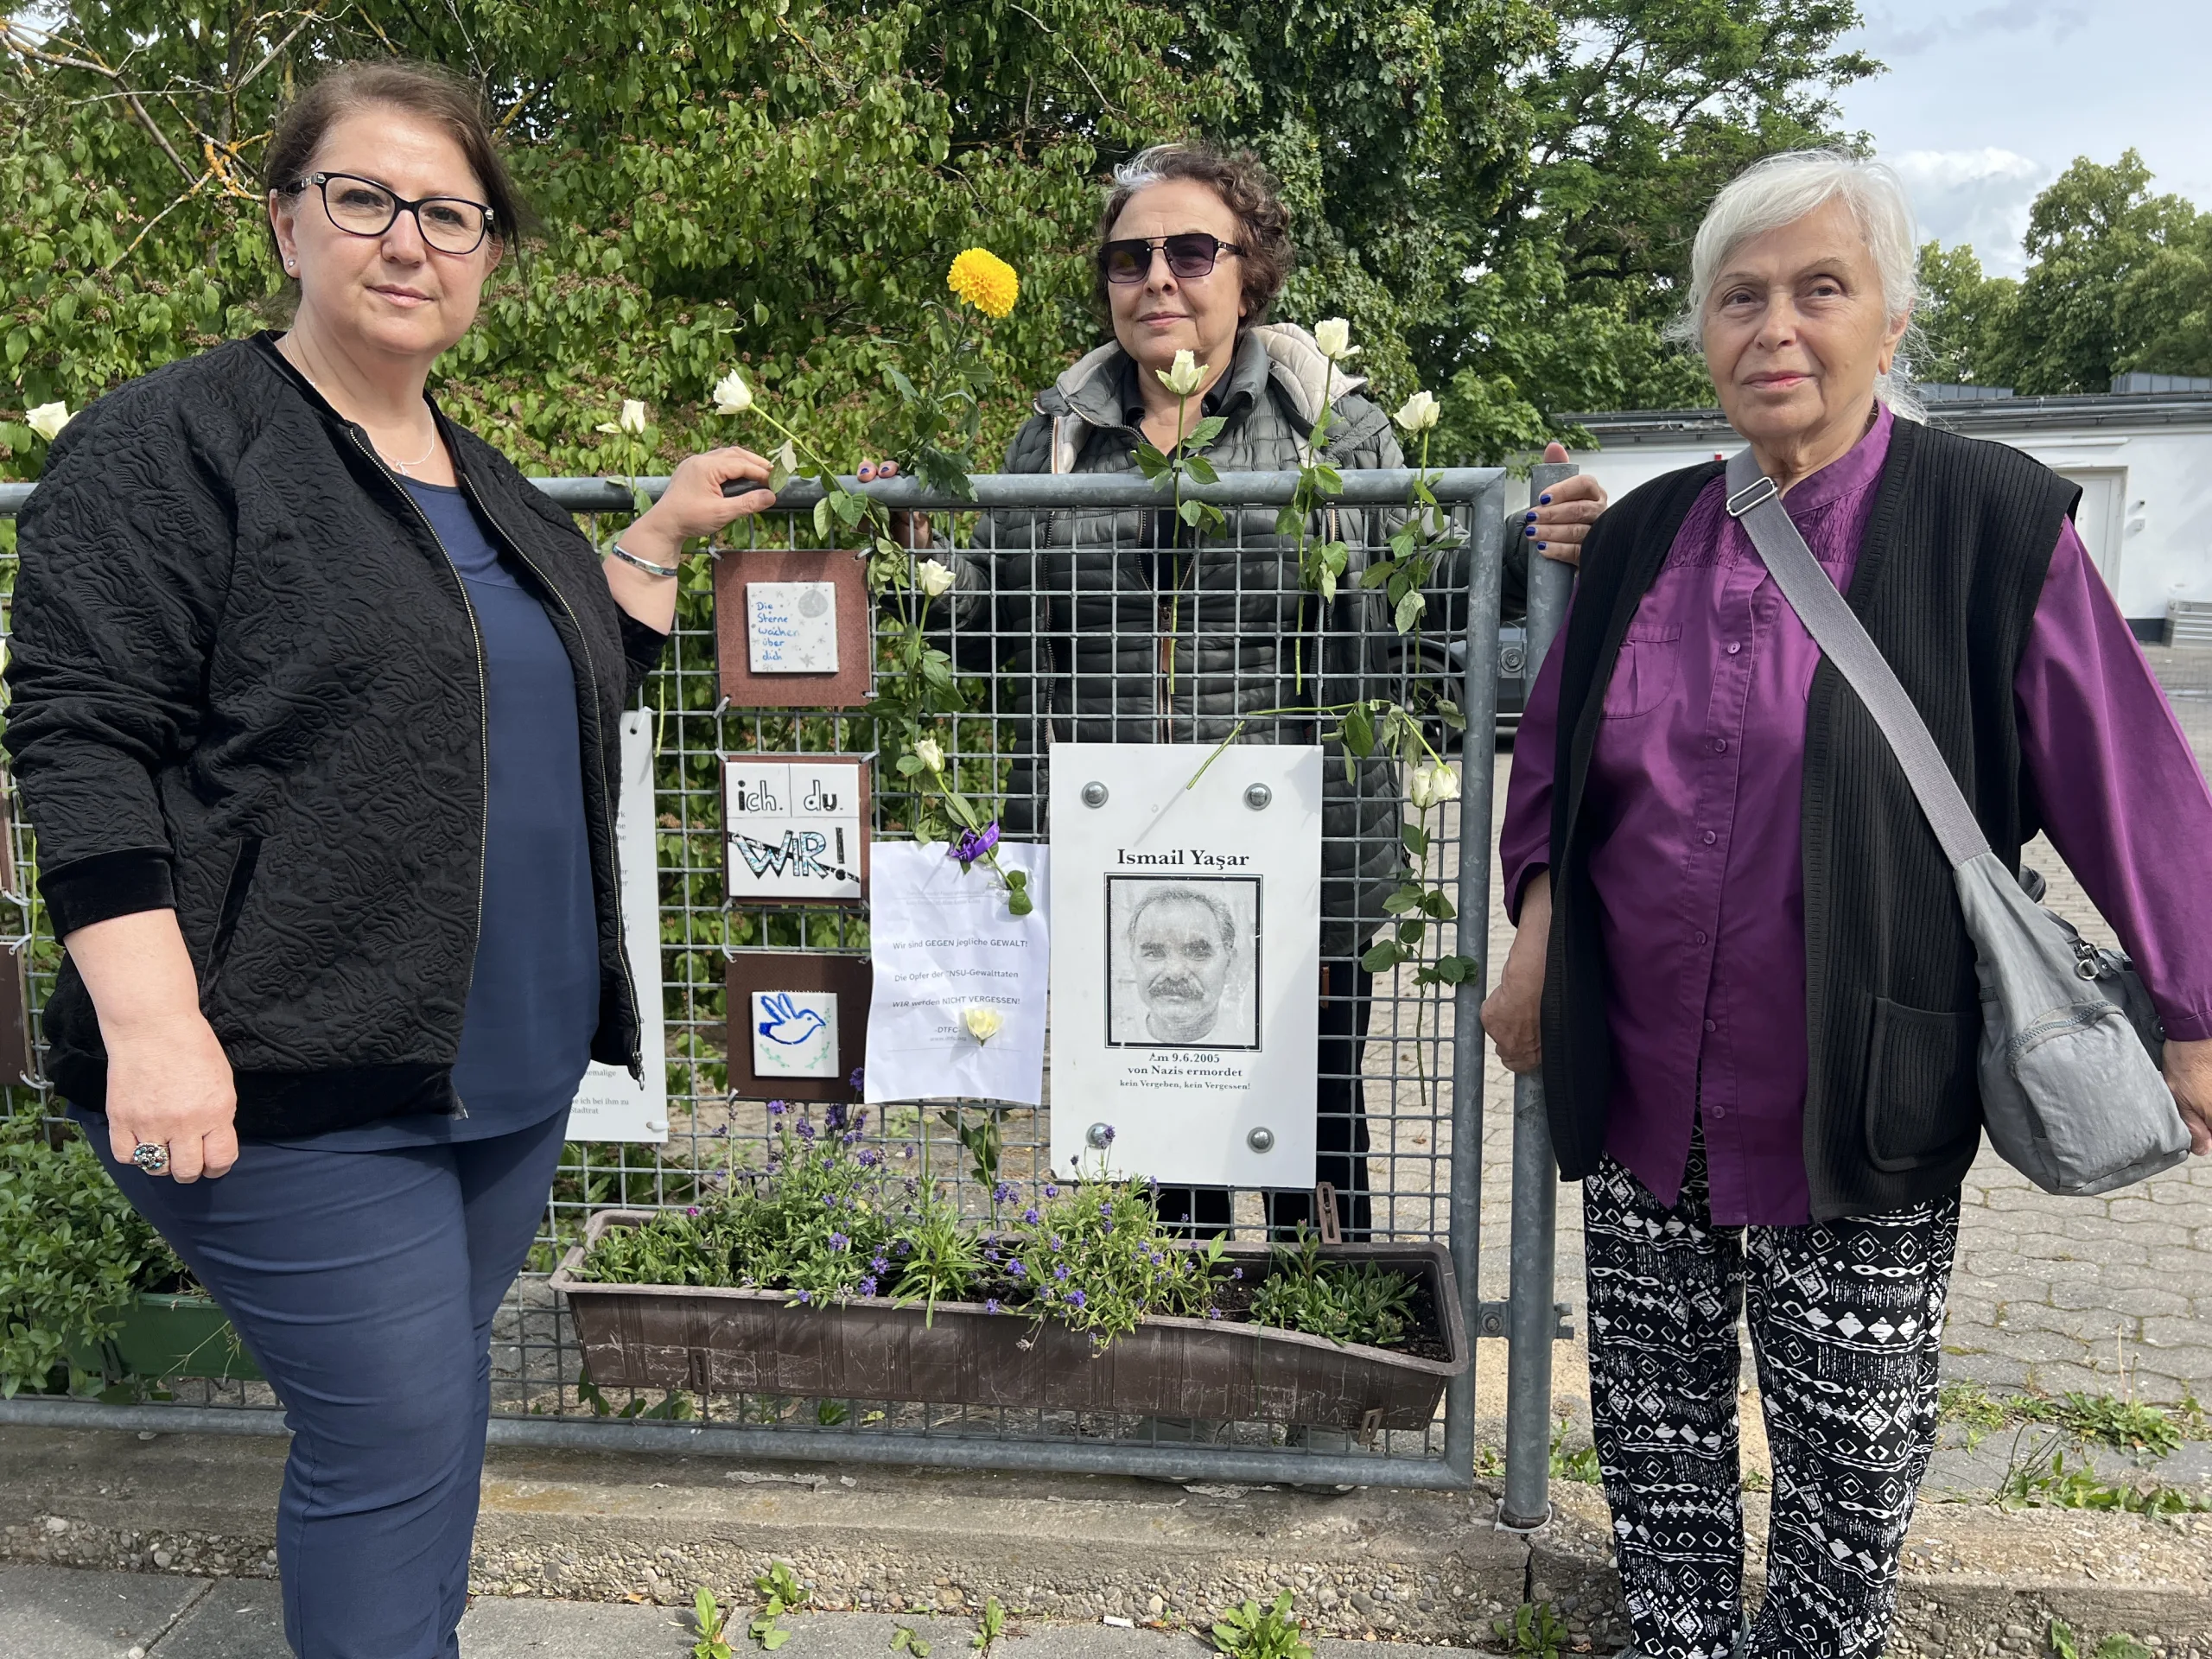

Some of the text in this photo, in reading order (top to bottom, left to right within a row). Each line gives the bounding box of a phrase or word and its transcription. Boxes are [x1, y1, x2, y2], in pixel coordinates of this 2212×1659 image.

[756, 601, 773, 611] Die
[757, 613, 788, 623] Sterne
[758, 626, 799, 637] wachen
[762, 638, 785, 647] über
[762, 651, 783, 661] dich
[733, 826, 848, 881] WIR!
[1116, 849, 1249, 871] Ismail Yaşar
[893, 941, 906, 950] Wir
[908, 939, 923, 949] sind
[956, 938, 988, 948] jegliche
[990, 938, 1028, 948] GEWALT!
[909, 971, 930, 981] Opfer
[942, 995, 966, 1005] NICHT
[969, 995, 1020, 1005] VERGESSEN!
[1148, 1052, 1220, 1064] Am 9.6.2005
[1151, 1065, 1184, 1075] Nazis
[1186, 1067, 1243, 1077] ermordet
[1140, 1080, 1182, 1090] Vergeben,
[1205, 1082, 1251, 1091] Vergessen!
